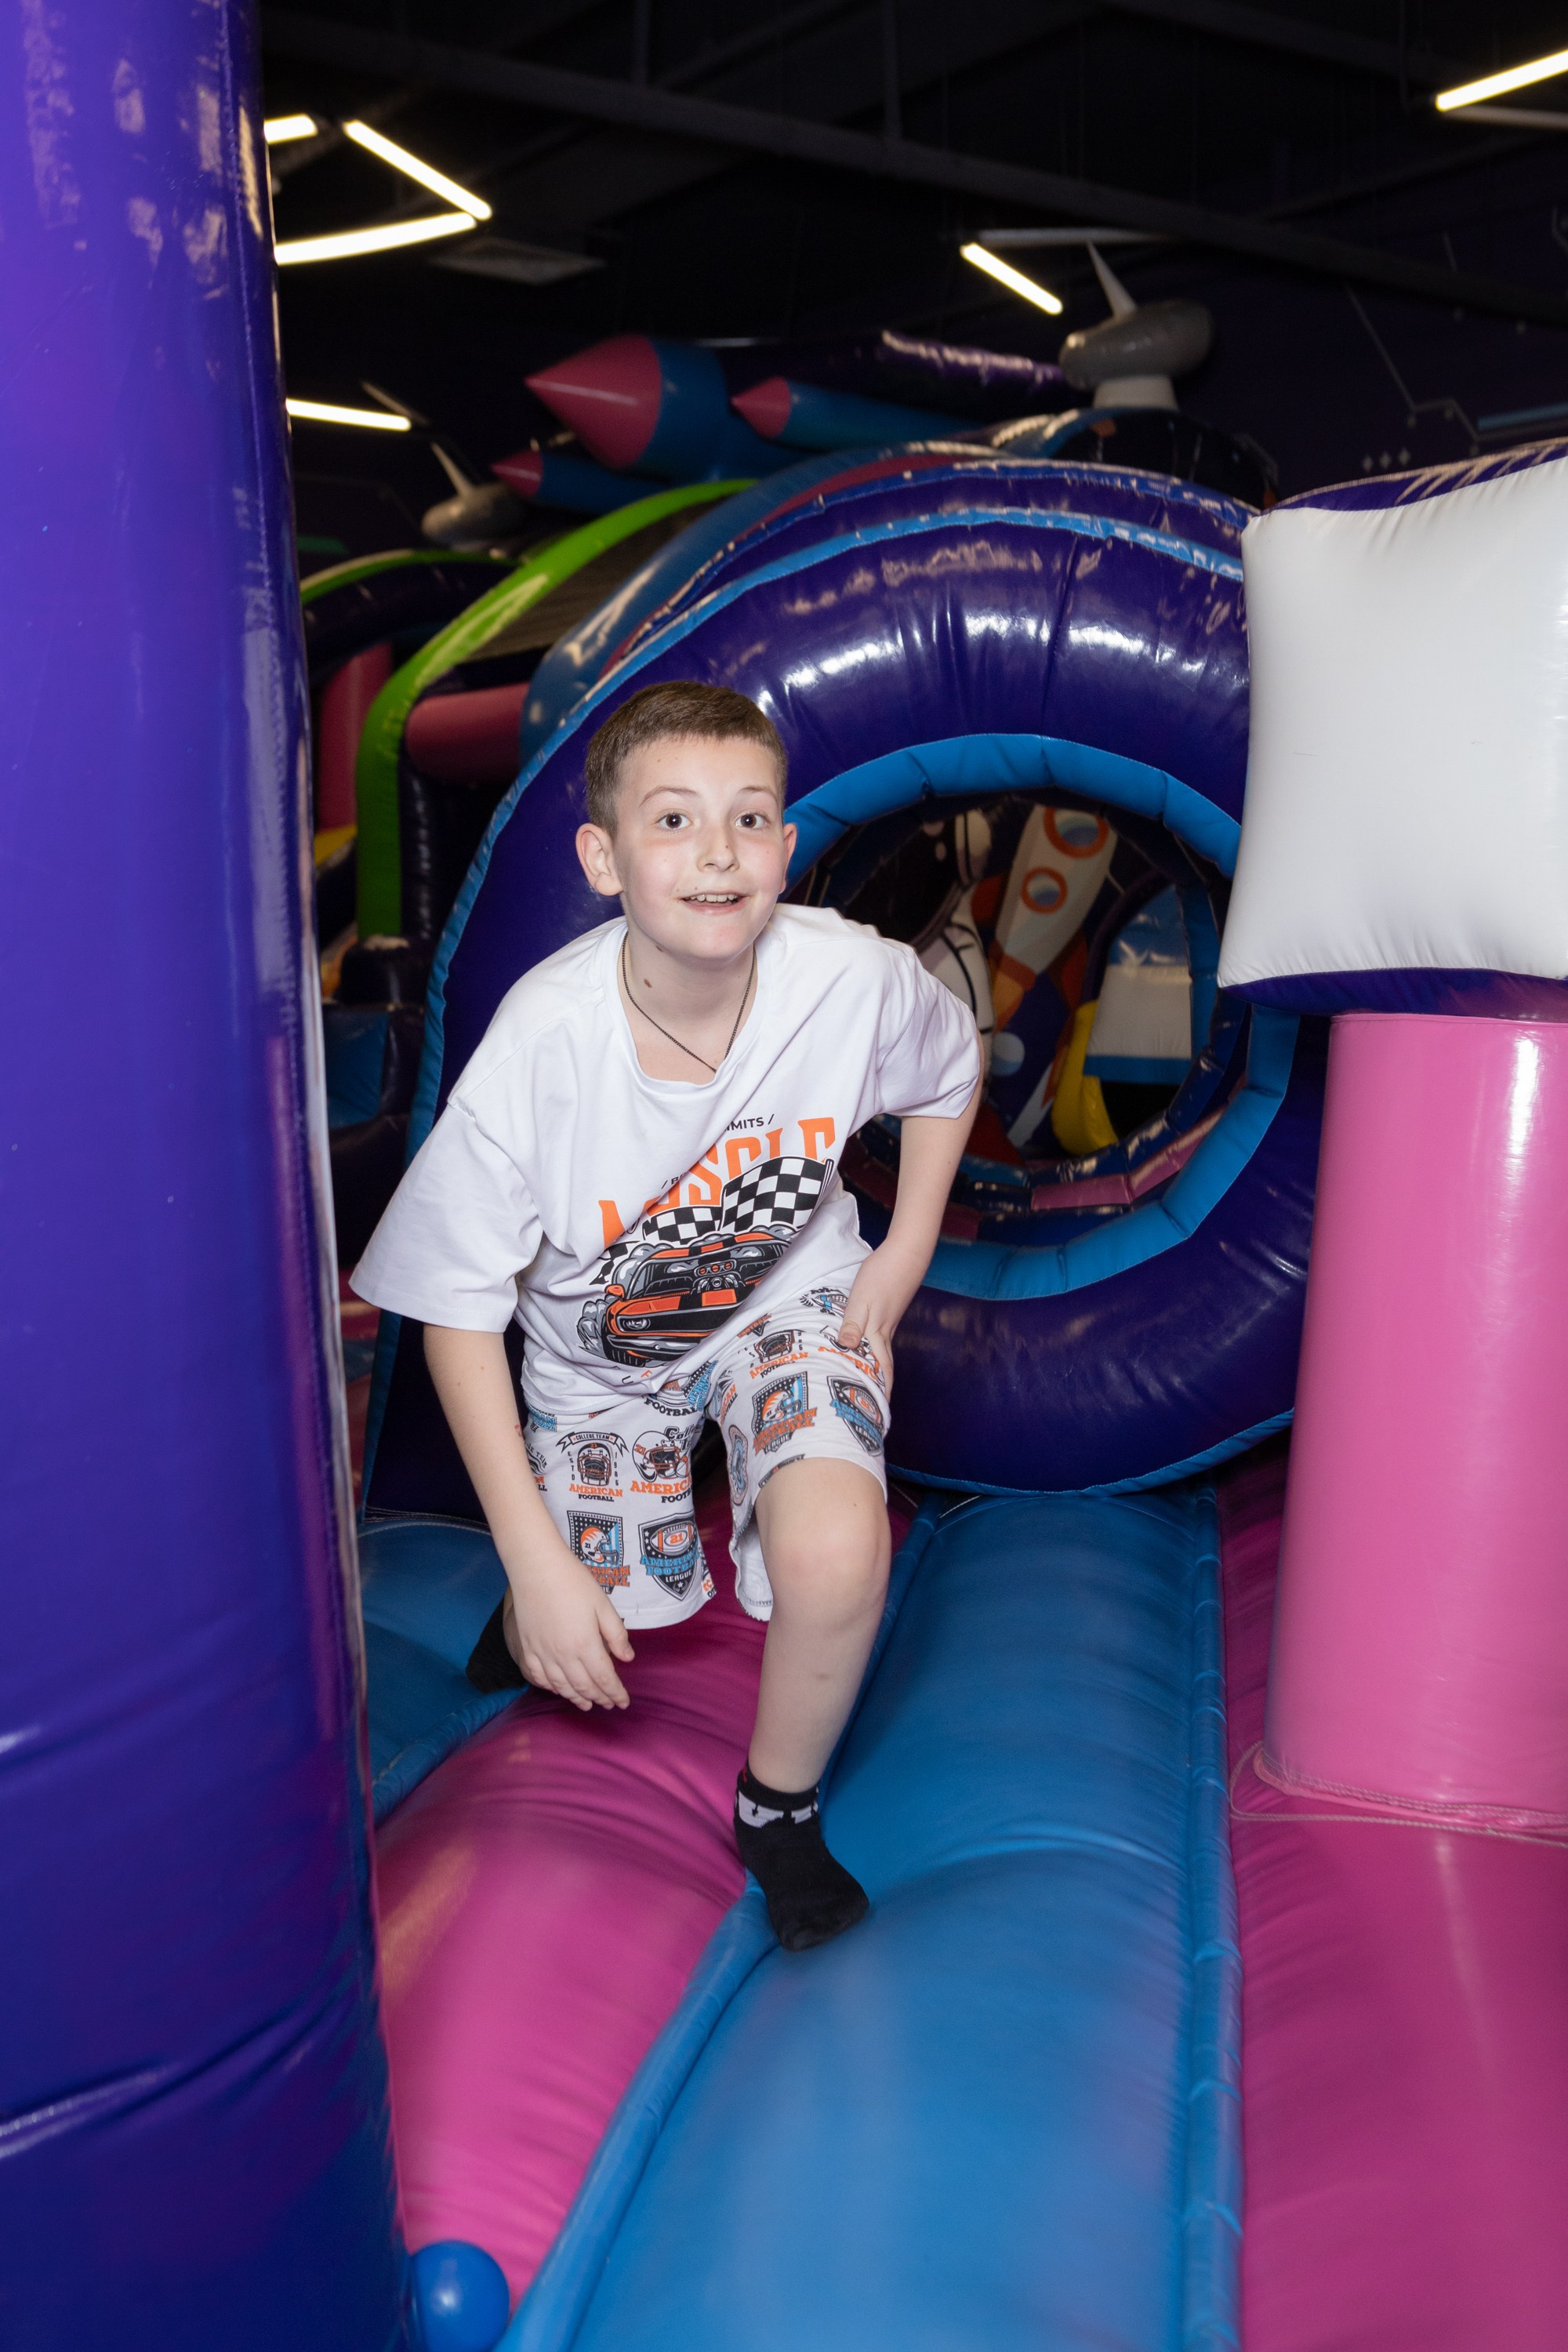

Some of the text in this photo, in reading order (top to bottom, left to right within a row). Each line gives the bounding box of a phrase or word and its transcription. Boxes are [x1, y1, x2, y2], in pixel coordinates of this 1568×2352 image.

[724, 1116, 764, 1131] IMITS
[760, 1362, 796, 1378] FOOT
[664, 1423, 695, 1440] Coll
[634, 1443, 646, 1455] 21
[568, 1483, 623, 1497] AMERICAN
[630, 1480, 692, 1495] AMERIC
[578, 1494, 615, 1502] FOOTBALL
[661, 1488, 692, 1504] FOOT
[670, 1533, 684, 1544] 21
[590, 1566, 630, 1577] RICAN
[665, 1570, 692, 1583] LEAGUE
[593, 1574, 630, 1588] BALL
